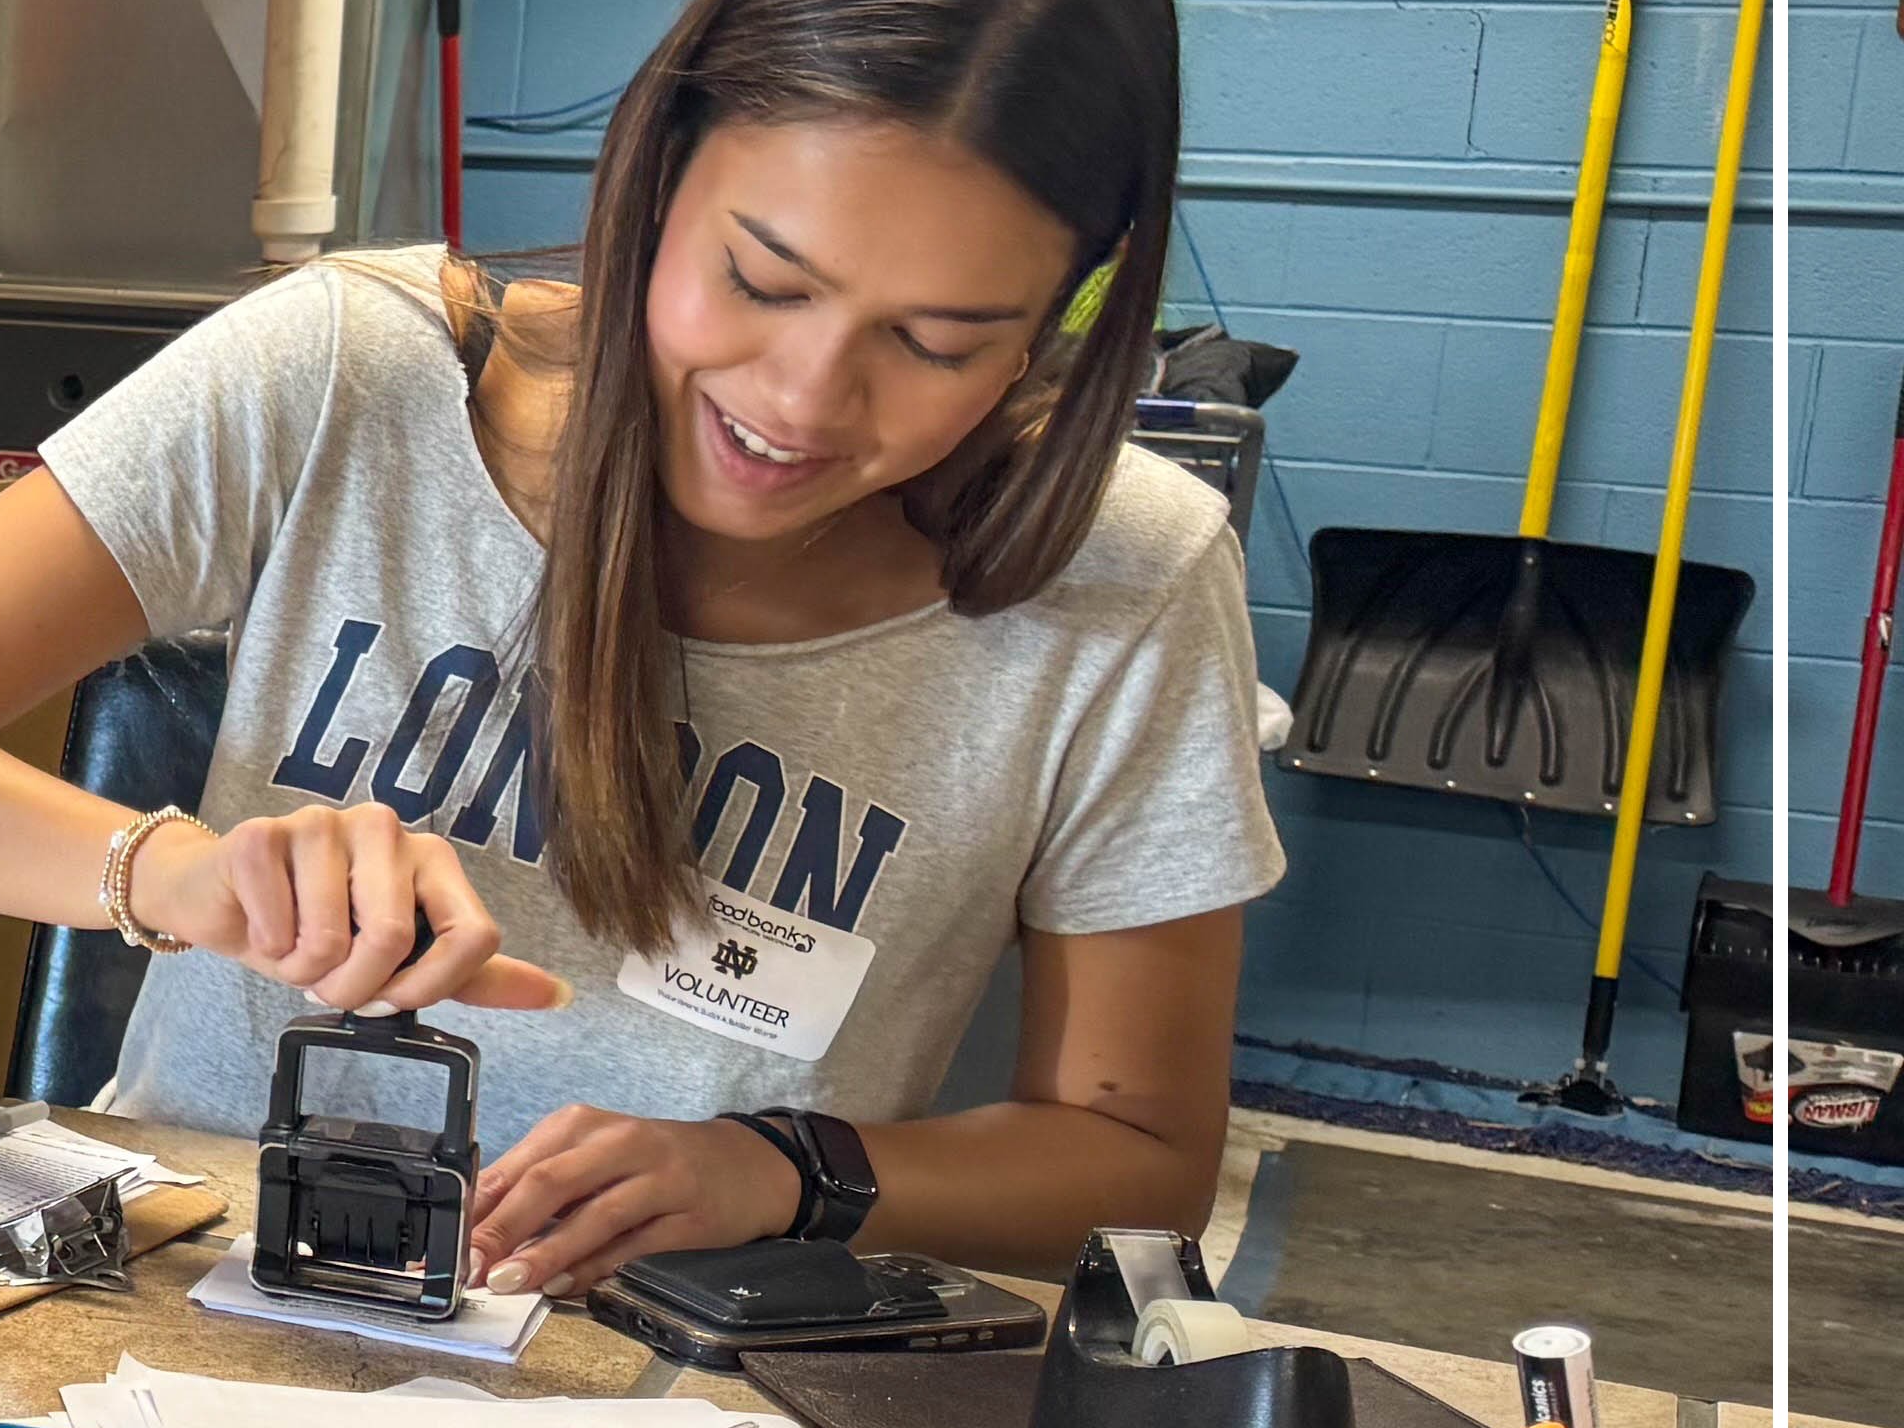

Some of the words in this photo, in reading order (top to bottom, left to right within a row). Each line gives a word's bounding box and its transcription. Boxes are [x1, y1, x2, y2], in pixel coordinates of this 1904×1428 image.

[269, 617, 909, 934] LONON
[707, 893, 800, 945] foodbank
[664, 962, 790, 1028] VOLUNTEER
